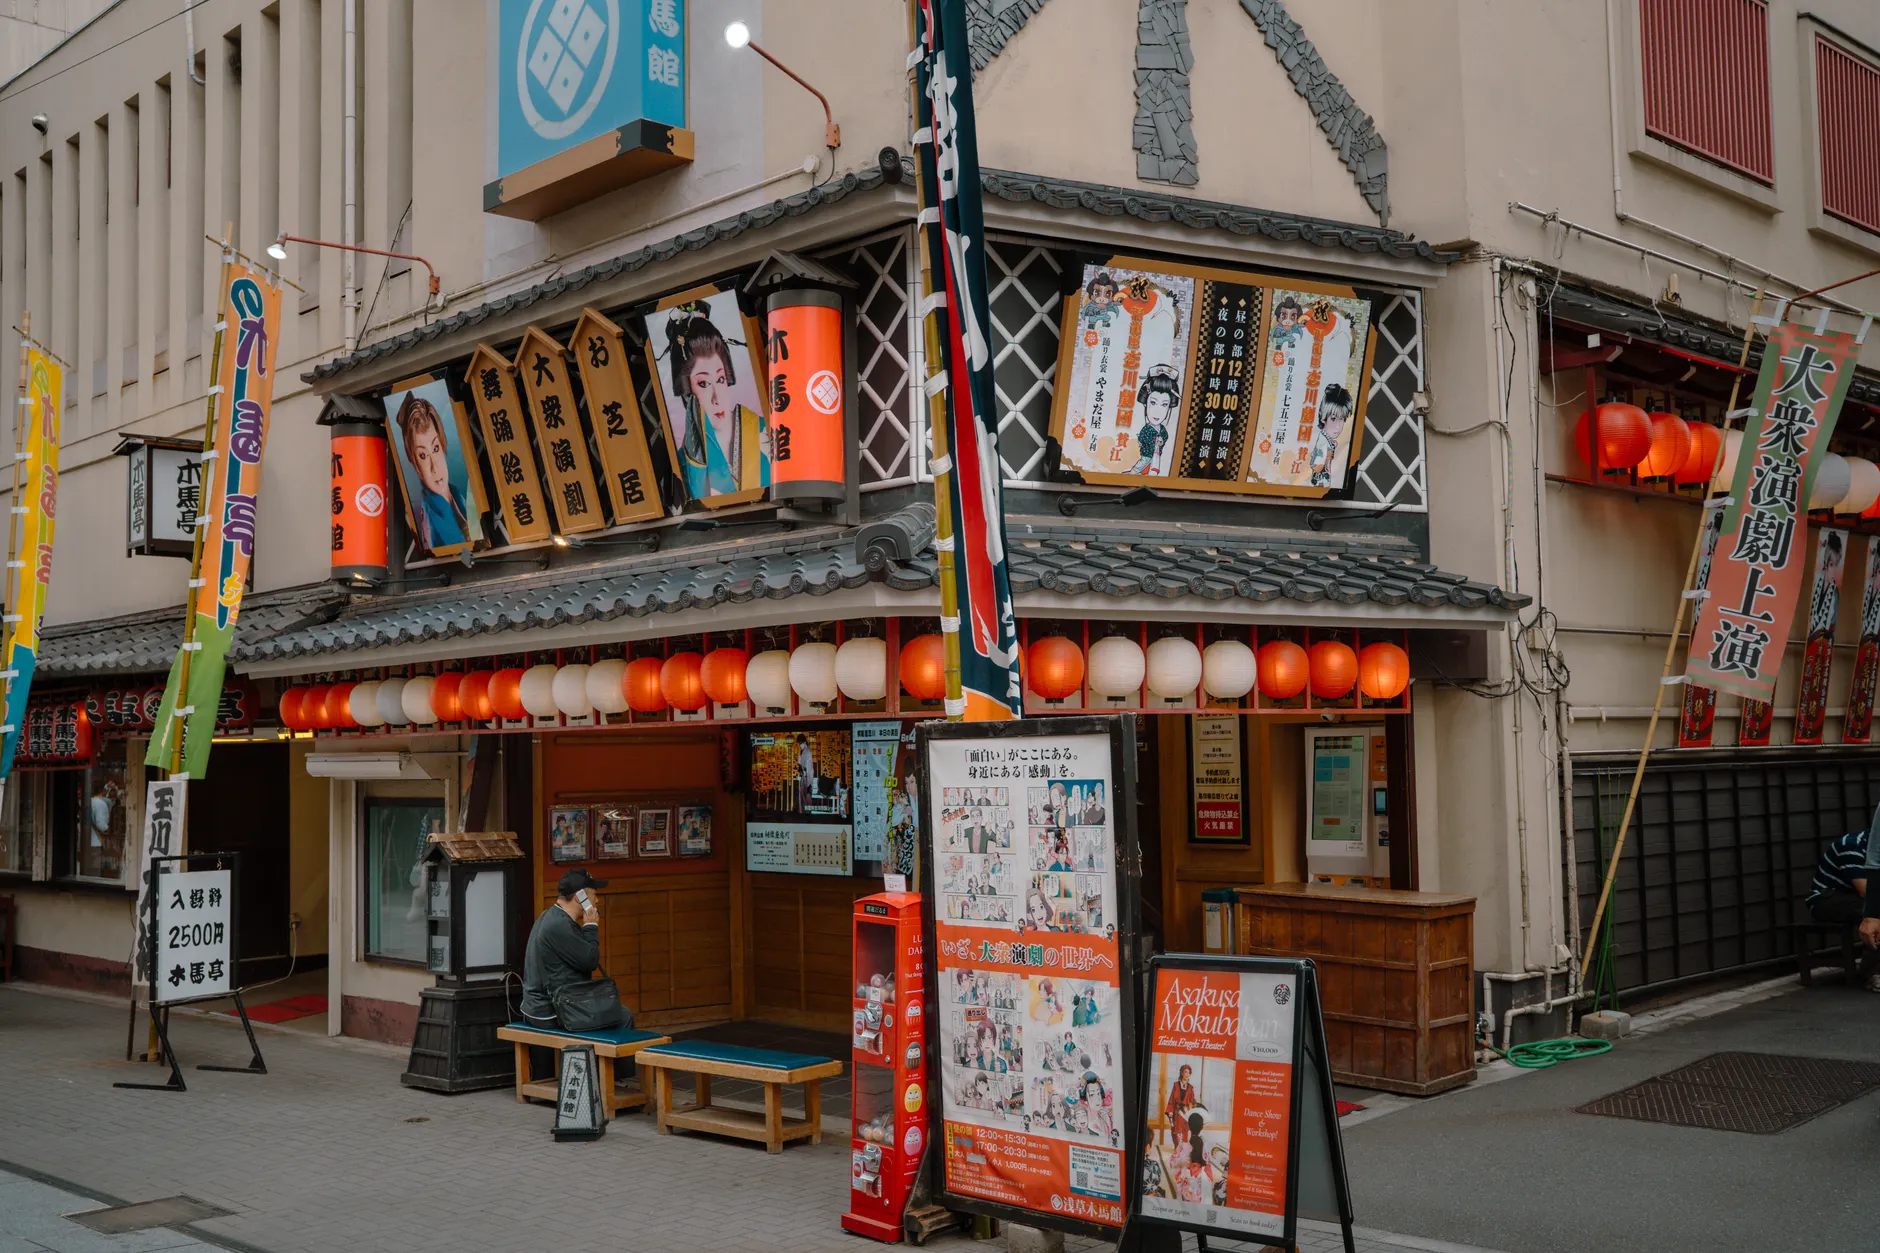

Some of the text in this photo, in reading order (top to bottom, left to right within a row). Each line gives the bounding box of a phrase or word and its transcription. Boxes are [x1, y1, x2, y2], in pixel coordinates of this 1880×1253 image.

[532, 352, 588, 516] 大衆演劇
[588, 336, 645, 506] お芝居
[480, 367, 535, 526] 舞踊絵巻
[133, 458, 145, 534] 木馬亭
[176, 458, 202, 534] 木馬亭
[1708, 346, 1837, 680] 大衆演劇上演
[965, 748, 1078, 763] 「面白い」がここにある。
[968, 764, 1075, 780] 身近にある「感動」を。
[169, 921, 224, 949] 2500円
[941, 938, 1113, 971] いざ、大衆演劇の世界へ
[1163, 976, 1242, 1008] Asakusa
[1252, 1046, 1278, 1054] ¥10,000
[1244, 1108, 1281, 1120] Dance Show
[1258, 1119, 1266, 1127] &
[1246, 1127, 1278, 1141] Workshop!
[1063, 1196, 1122, 1222] 浅草木馬館
